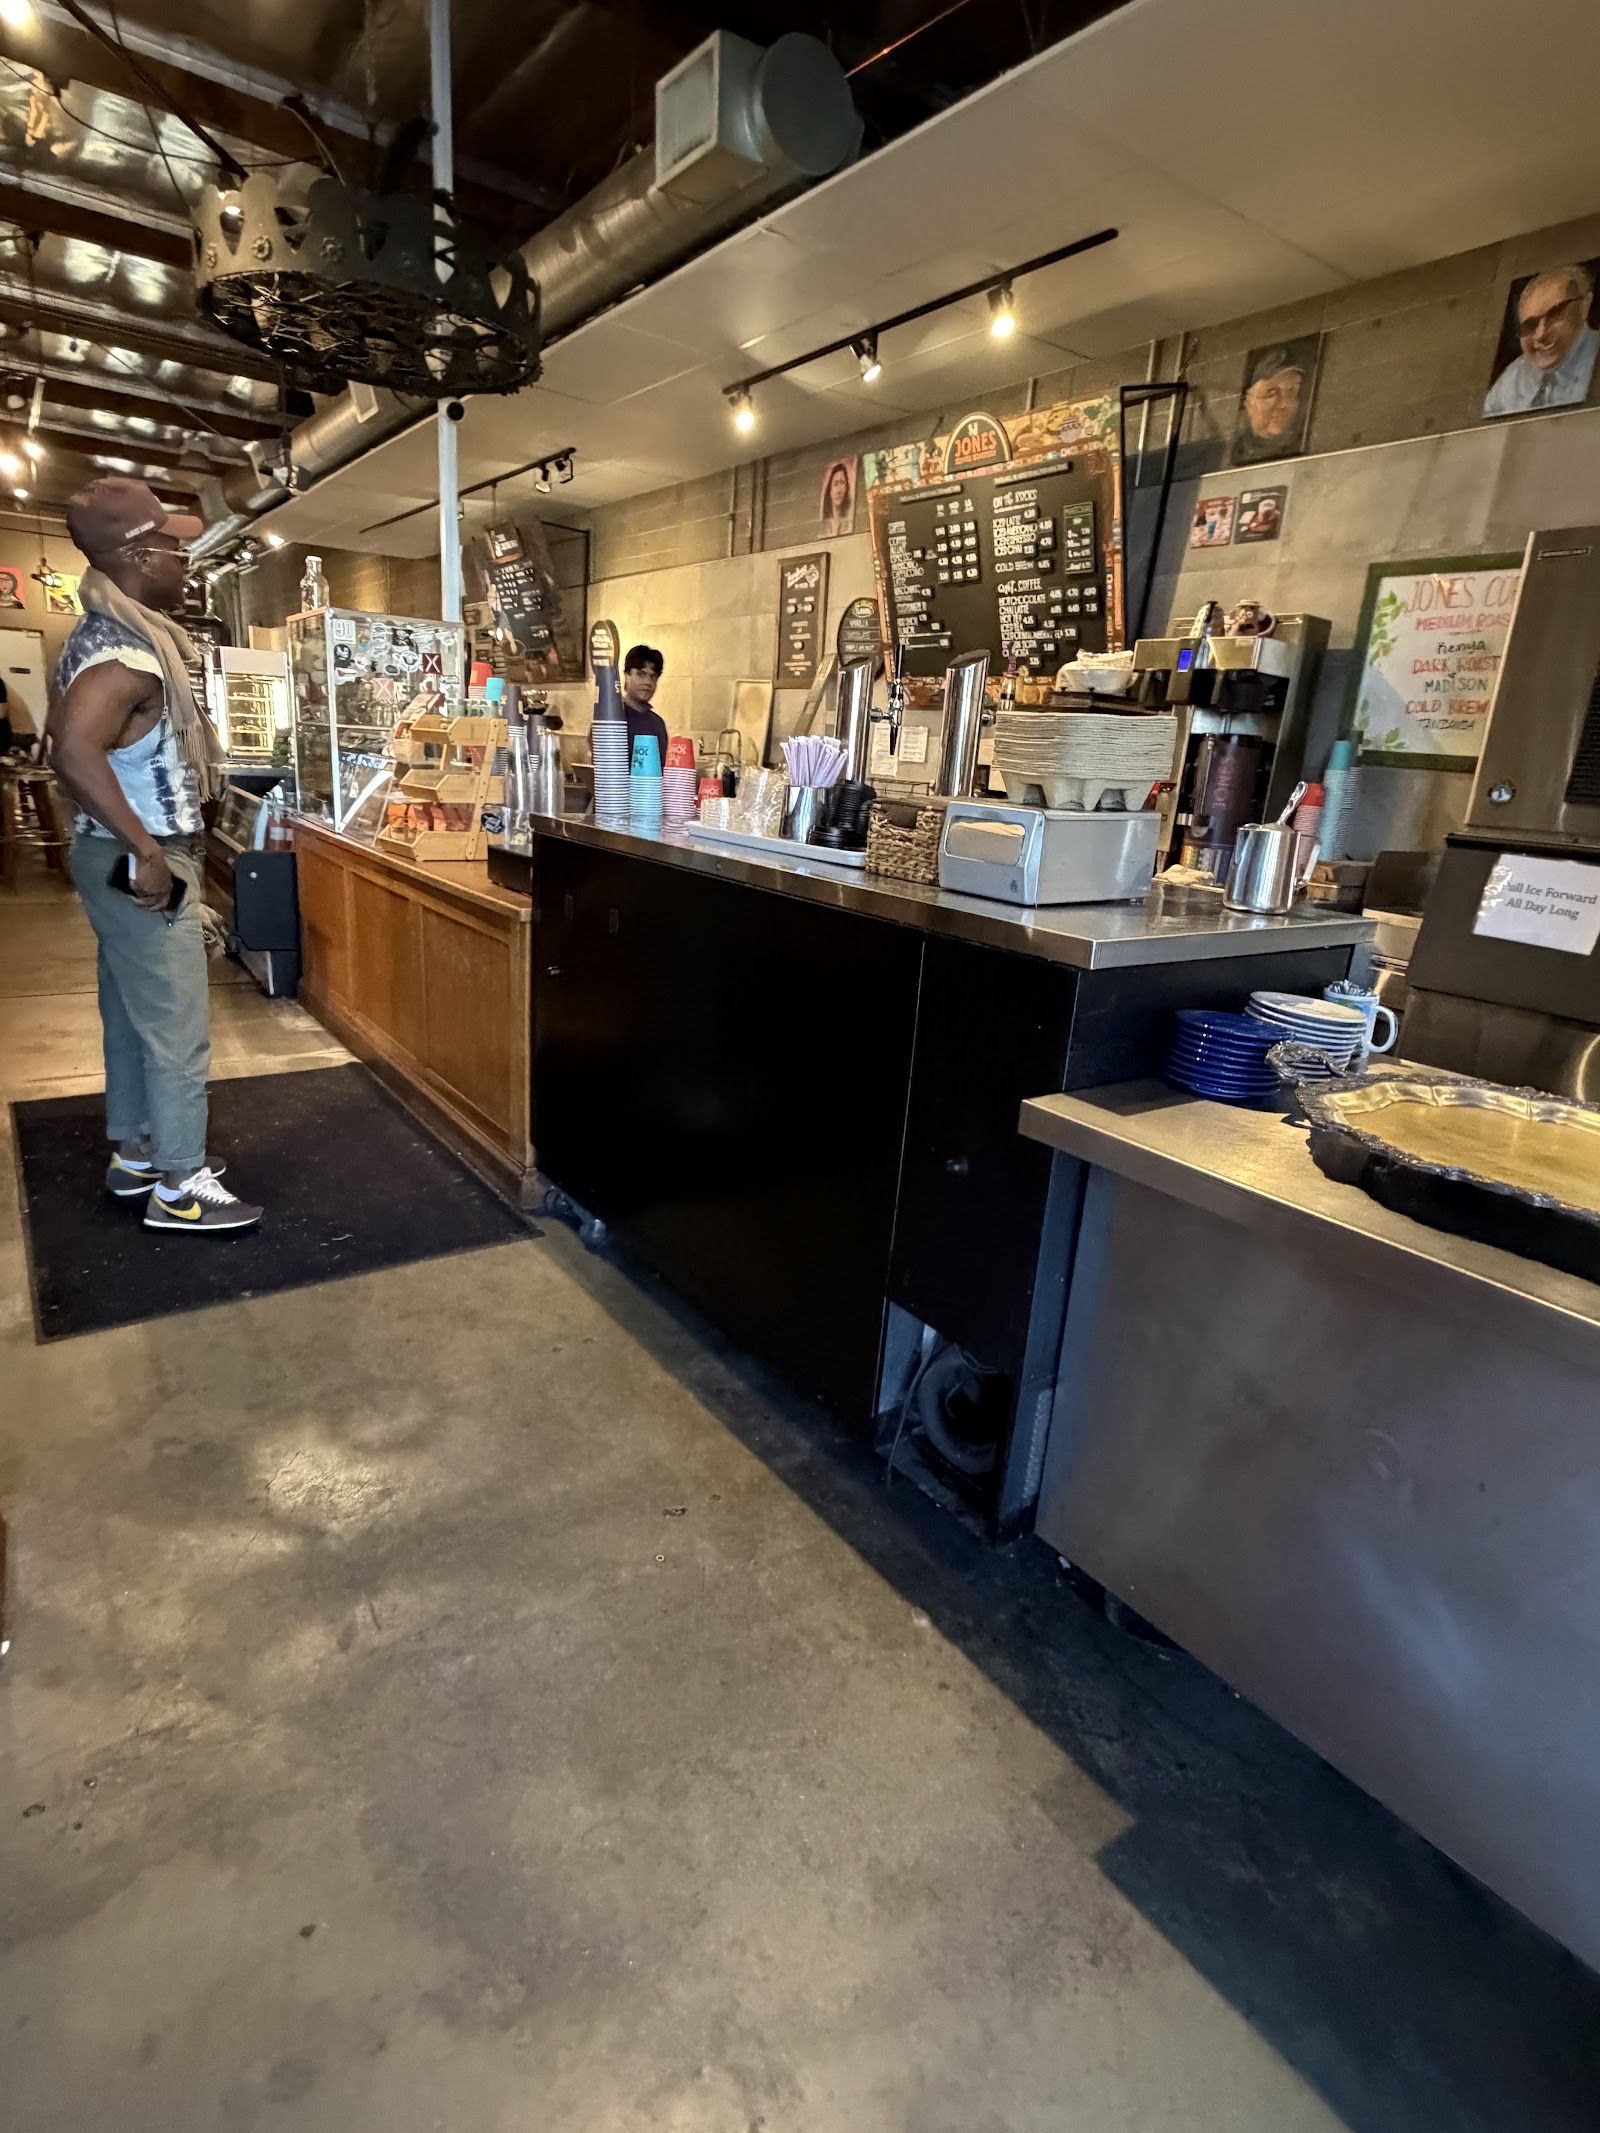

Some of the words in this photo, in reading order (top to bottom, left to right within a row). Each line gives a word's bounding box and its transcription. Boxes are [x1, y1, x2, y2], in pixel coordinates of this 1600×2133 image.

[955, 431, 997, 457] JONES
[1015, 489, 1038, 503] ROCKS
[995, 562, 1014, 573] COLD
[1011, 594, 1046, 605] CHOCOLATE
[1416, 615, 1474, 631] MEDIUM
[1478, 612, 1510, 629] ROAS
[1437, 641, 1487, 655] Kenya
[1412, 658, 1447, 675] DARK
[1405, 700, 1441, 715] COLD
[1447, 700, 1489, 715] BREW
[1525, 885, 1543, 896] Ice
[1545, 887, 1598, 905] Forward
[1505, 897, 1523, 908] All
[1523, 900, 1548, 915] Day
[1548, 904, 1580, 920] Long
